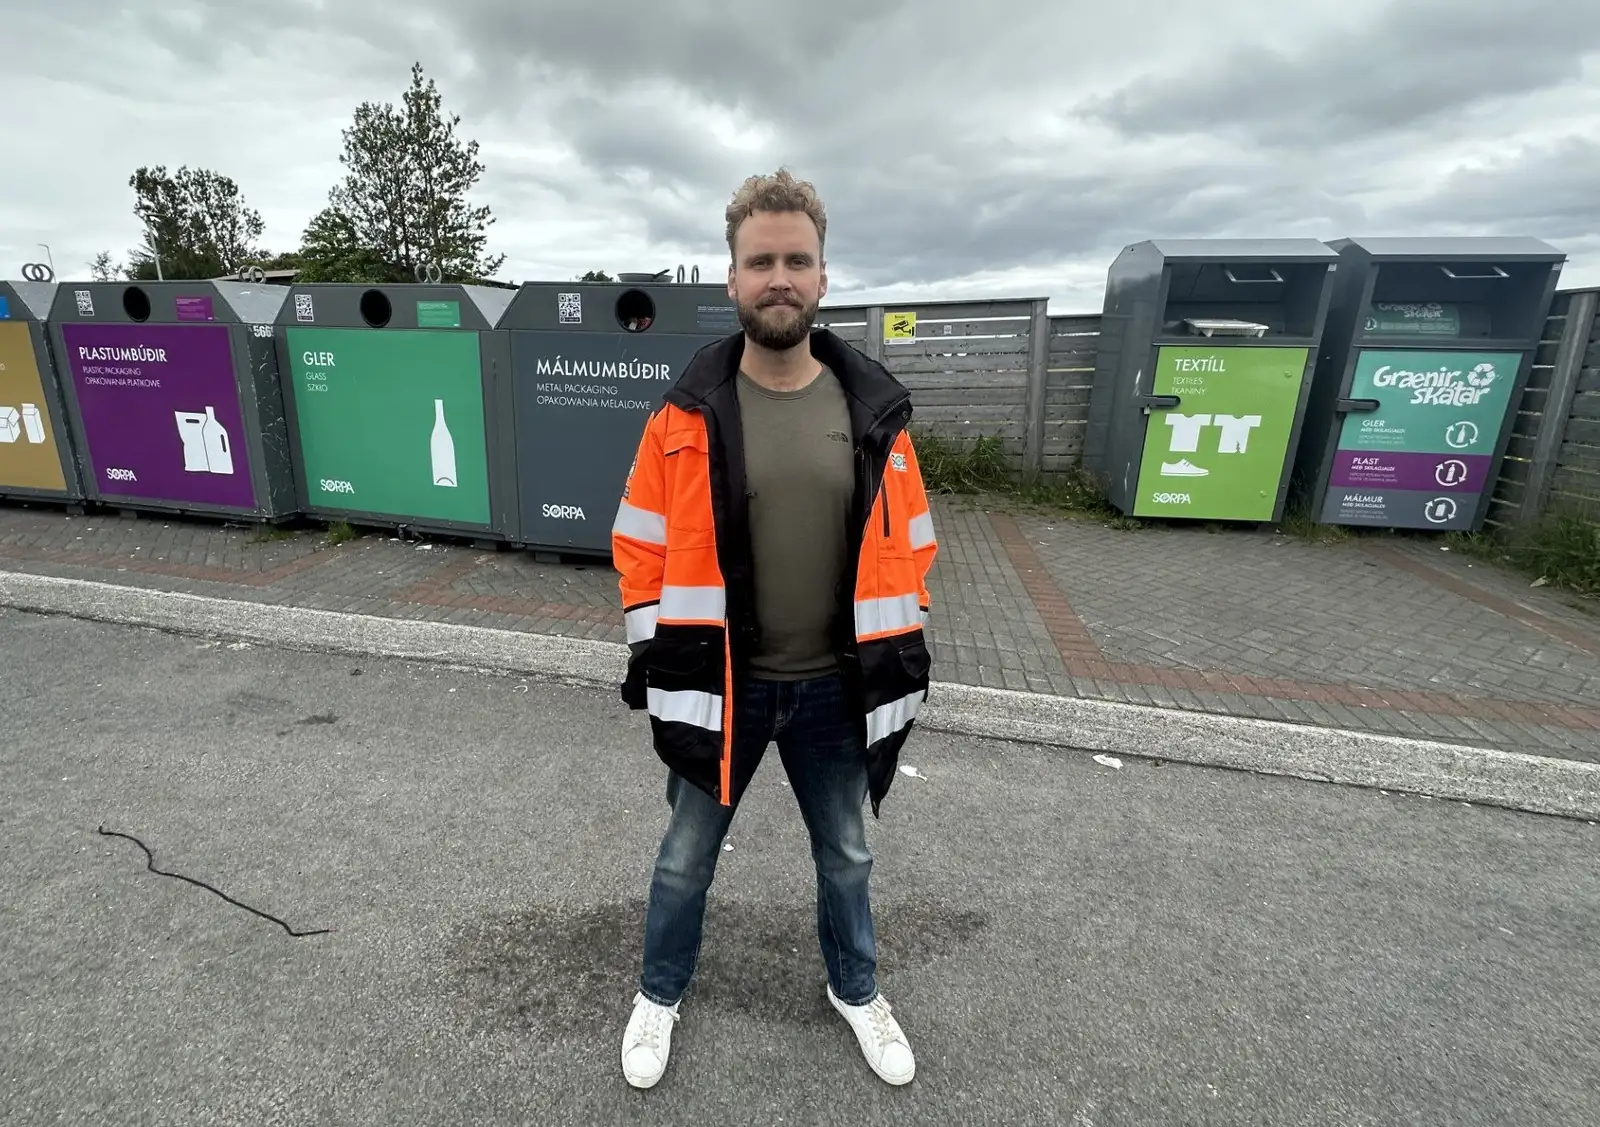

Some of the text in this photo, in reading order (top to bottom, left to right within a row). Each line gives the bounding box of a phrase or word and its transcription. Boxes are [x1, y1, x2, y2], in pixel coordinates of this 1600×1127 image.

[78, 344, 168, 362] PLASTUMBÚÐIR
[303, 351, 336, 367] GLER
[536, 355, 671, 380] MÁLMUMBÚÐIR
[1175, 355, 1226, 372] TEXTÍLL
[105, 367, 142, 376] PACKAGING
[305, 371, 327, 381] GLASS
[1373, 365, 1463, 389] Graenir
[536, 383, 618, 396] METAL PACKAGING
[536, 396, 599, 407] OPAKOWANIA
[1362, 419, 1386, 427] GLER
[1352, 457, 1380, 465] PLAST
[106, 467, 138, 482] SORPA
[320, 478, 355, 494] SORPA
[1152, 492, 1192, 505] SORPA
[1343, 493, 1383, 503] MÁLMUR
[542, 503, 586, 520] SORPA
